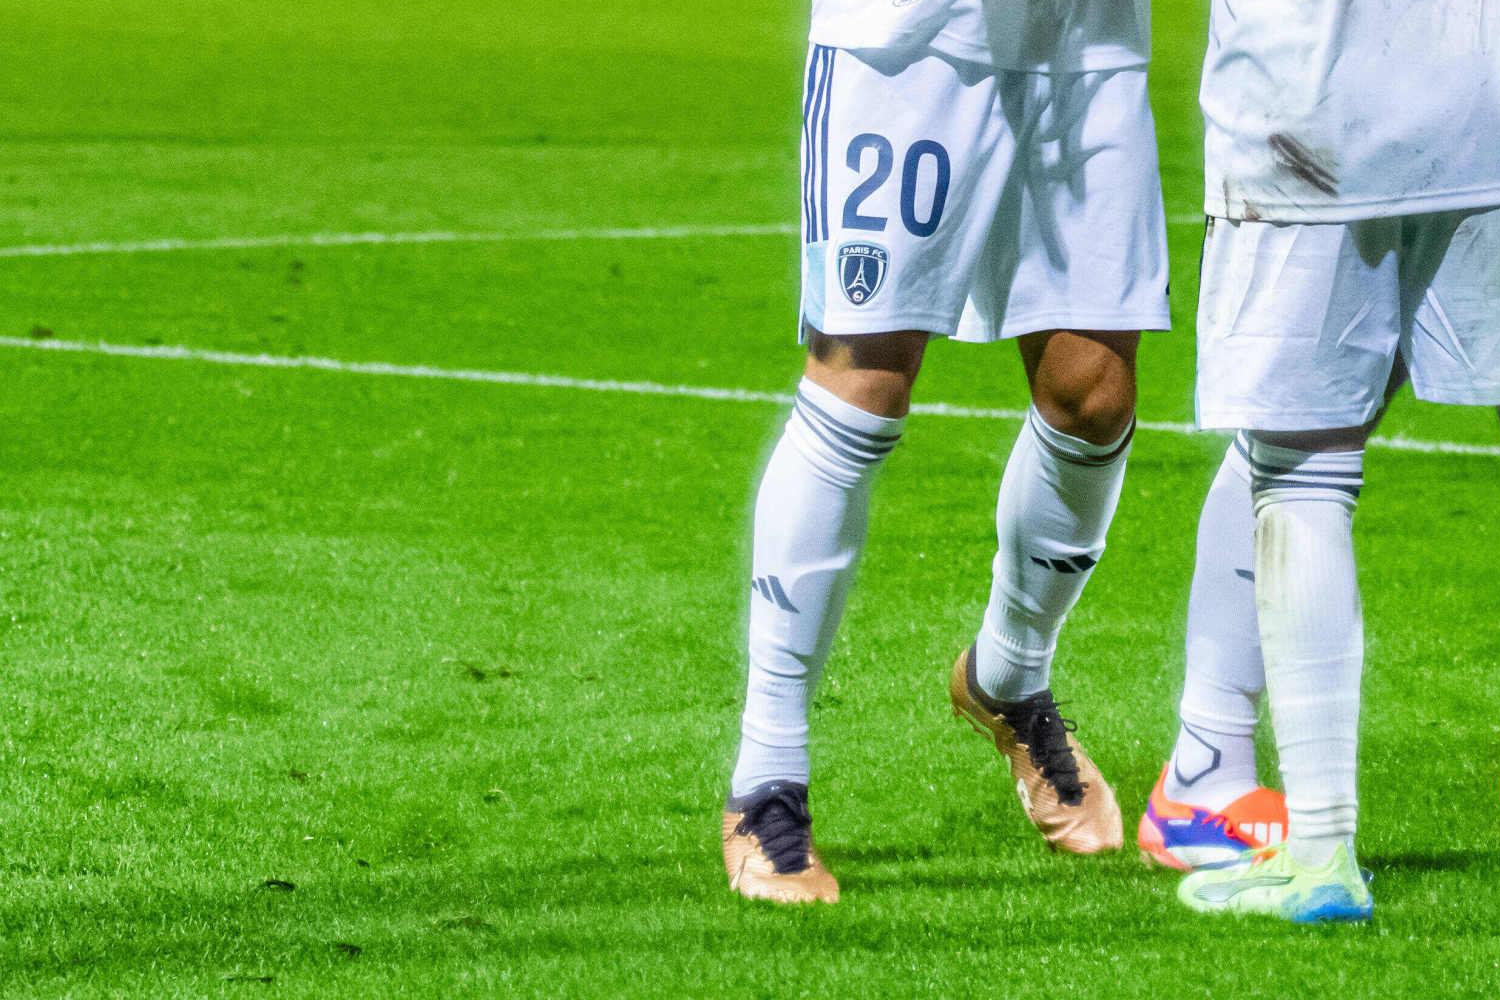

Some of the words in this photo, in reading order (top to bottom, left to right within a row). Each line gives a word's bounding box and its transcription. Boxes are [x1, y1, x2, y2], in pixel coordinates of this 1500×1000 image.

[841, 132, 951, 238] 20
[843, 246, 870, 255] PARIS
[872, 249, 884, 258] FC
